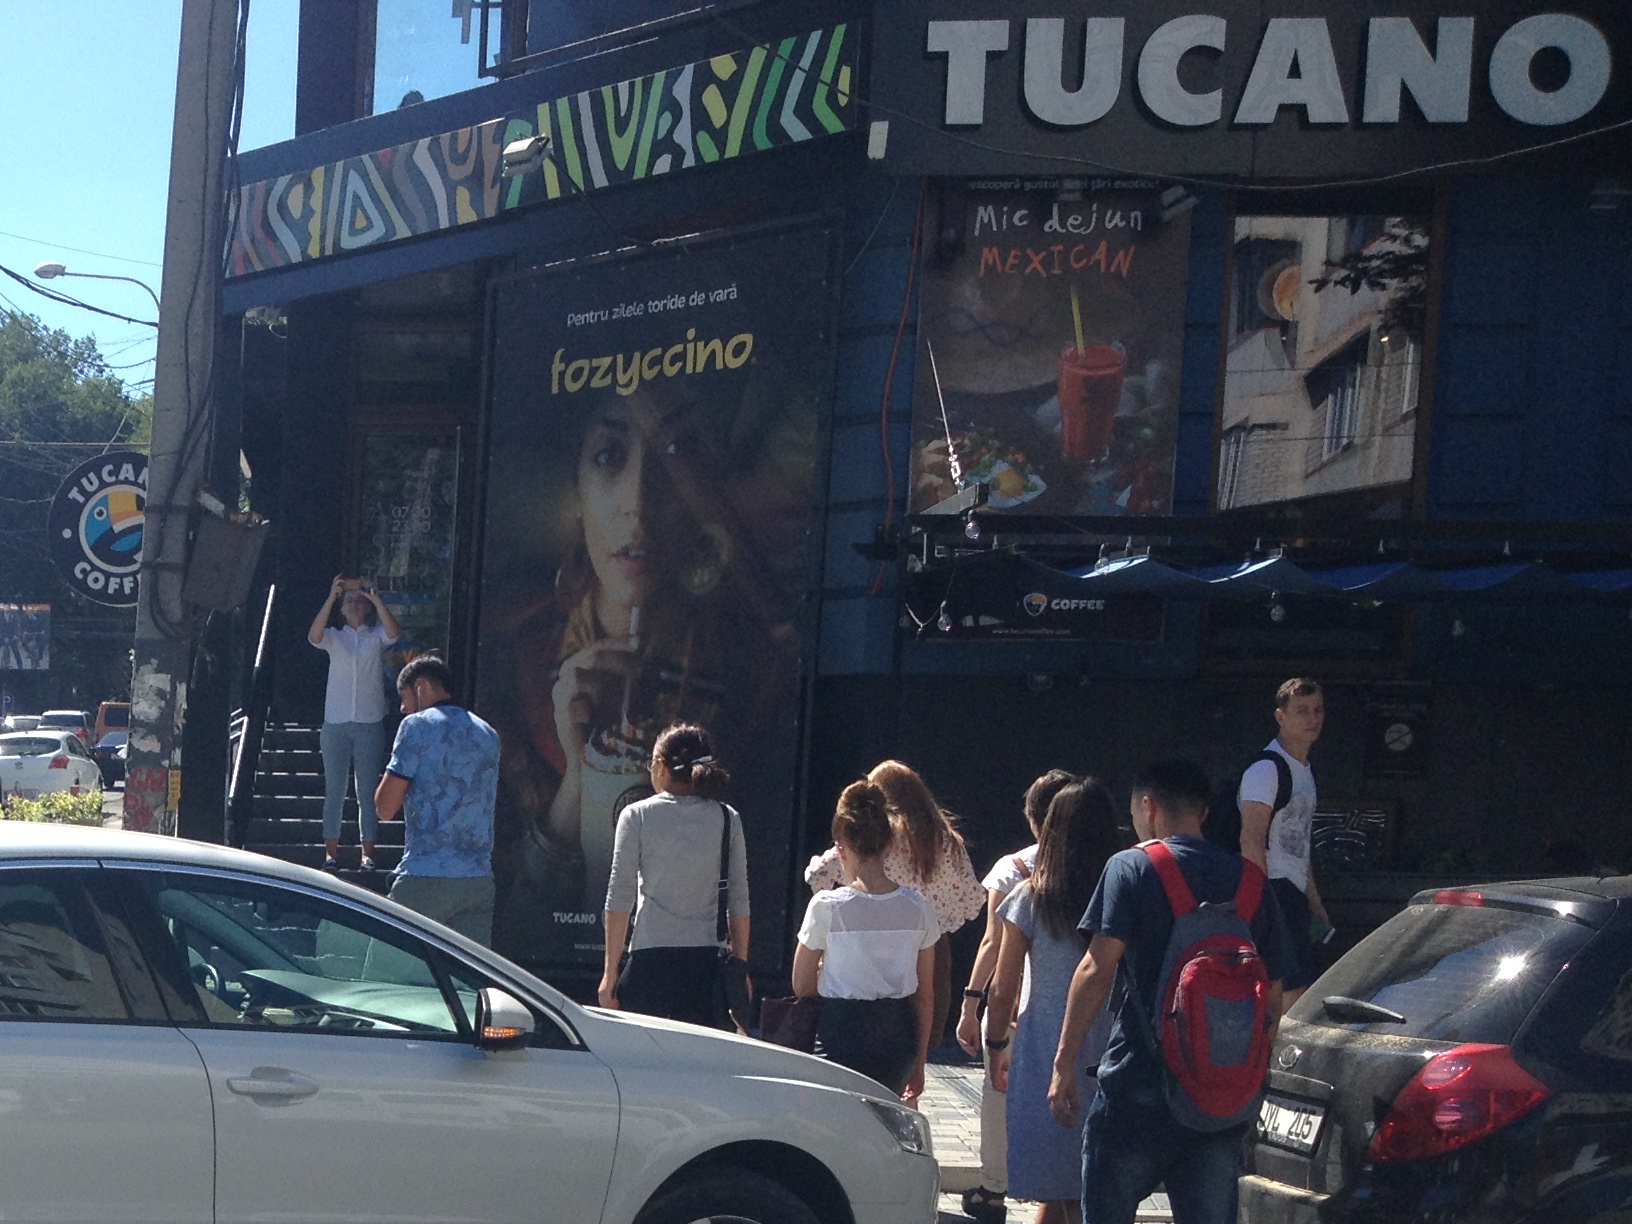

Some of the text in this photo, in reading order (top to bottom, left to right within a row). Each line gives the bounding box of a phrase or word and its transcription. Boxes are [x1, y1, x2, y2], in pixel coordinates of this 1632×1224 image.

[927, 13, 1612, 126] TUCANO
[974, 203, 1142, 237] Mic dejun
[979, 240, 1136, 278] MEXICAN
[648, 295, 686, 313] toride
[689, 290, 706, 306] de
[709, 282, 738, 303] vară
[551, 328, 754, 396] fozyccino
[68, 463, 148, 503] TUCAN
[74, 562, 141, 594] COFF
[1050, 599, 1105, 610] COFFEE
[552, 911, 597, 924] TUCANO
